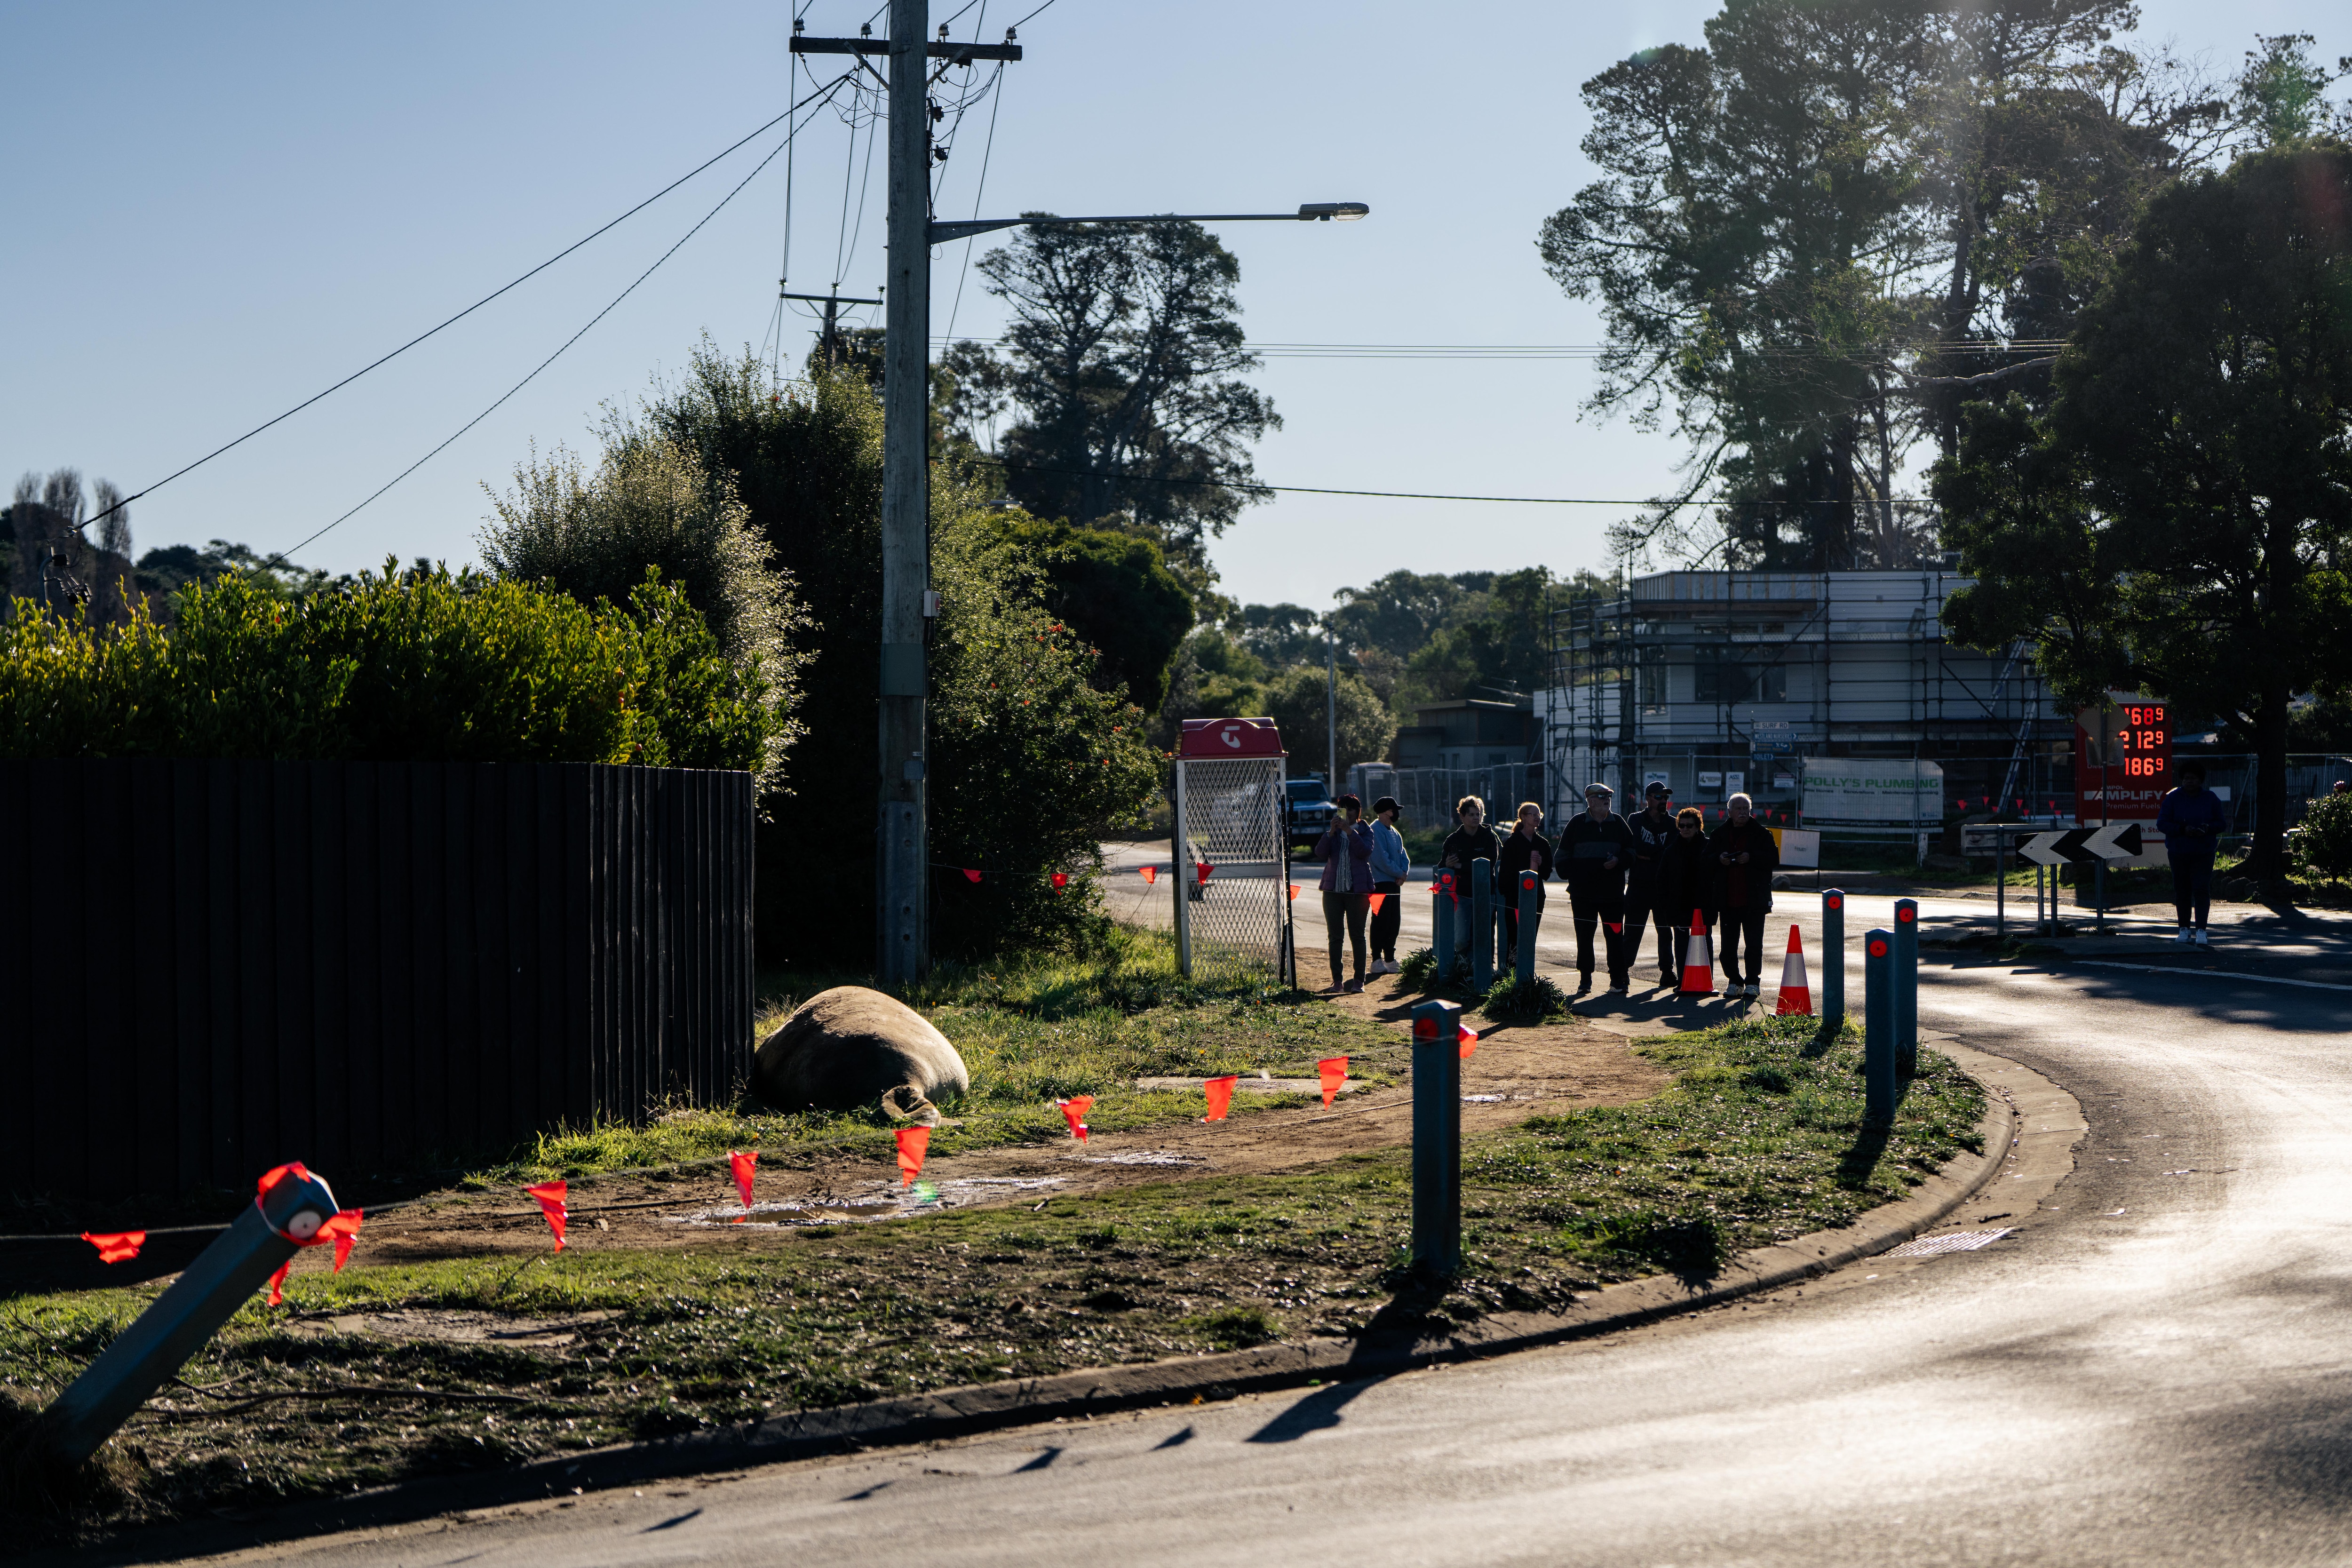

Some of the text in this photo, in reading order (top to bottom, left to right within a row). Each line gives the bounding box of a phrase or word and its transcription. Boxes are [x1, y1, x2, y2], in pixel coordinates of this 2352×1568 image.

[1804, 776, 1860, 788] POLLY'S
[1865, 779, 1939, 788] PLUMBNG
[2094, 790, 2164, 801] AMPLIFY
